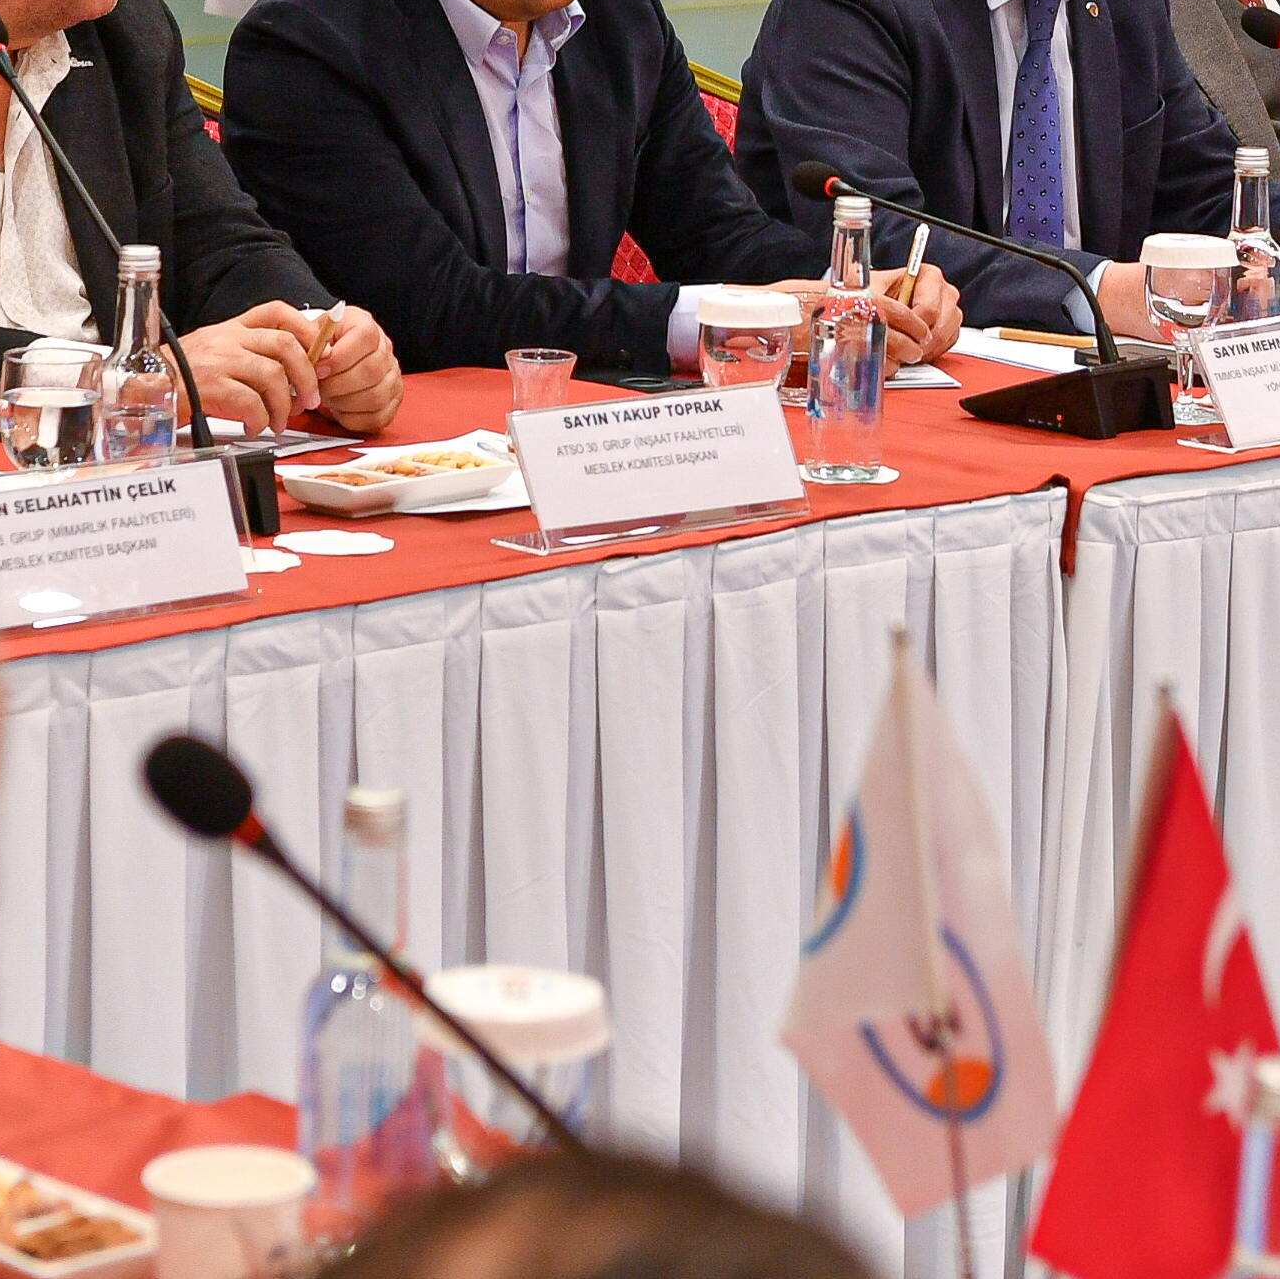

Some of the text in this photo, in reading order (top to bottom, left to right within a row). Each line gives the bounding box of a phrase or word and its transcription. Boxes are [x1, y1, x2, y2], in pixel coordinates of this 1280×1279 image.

[1213, 342, 1250, 359] SAYIN
[1214, 368, 1242, 382] TMMOB
[1241, 363, 1270, 378] İNŞAAT
[563, 398, 724, 430] SAYIN YAKUP TOPRAK
[556, 443, 585, 456] ATSO
[603, 437, 632, 451] GRUP
[633, 432, 673, 450] (İNŞAAT
[673, 423, 746, 443] FAALİYETLERİ)
[583, 449, 719, 476] MESLEK KOMİTESİ BAŞKANI
[13, 484, 122, 515] SELAHATTİN
[126, 477, 177, 502] ÇELİK
[9, 528, 44, 545] GRUP
[110, 505, 197, 531] FAALİYETLERİ)
[47, 543, 104, 564] KOMİTESİ
[106, 537, 158, 555] BAŞKANI
